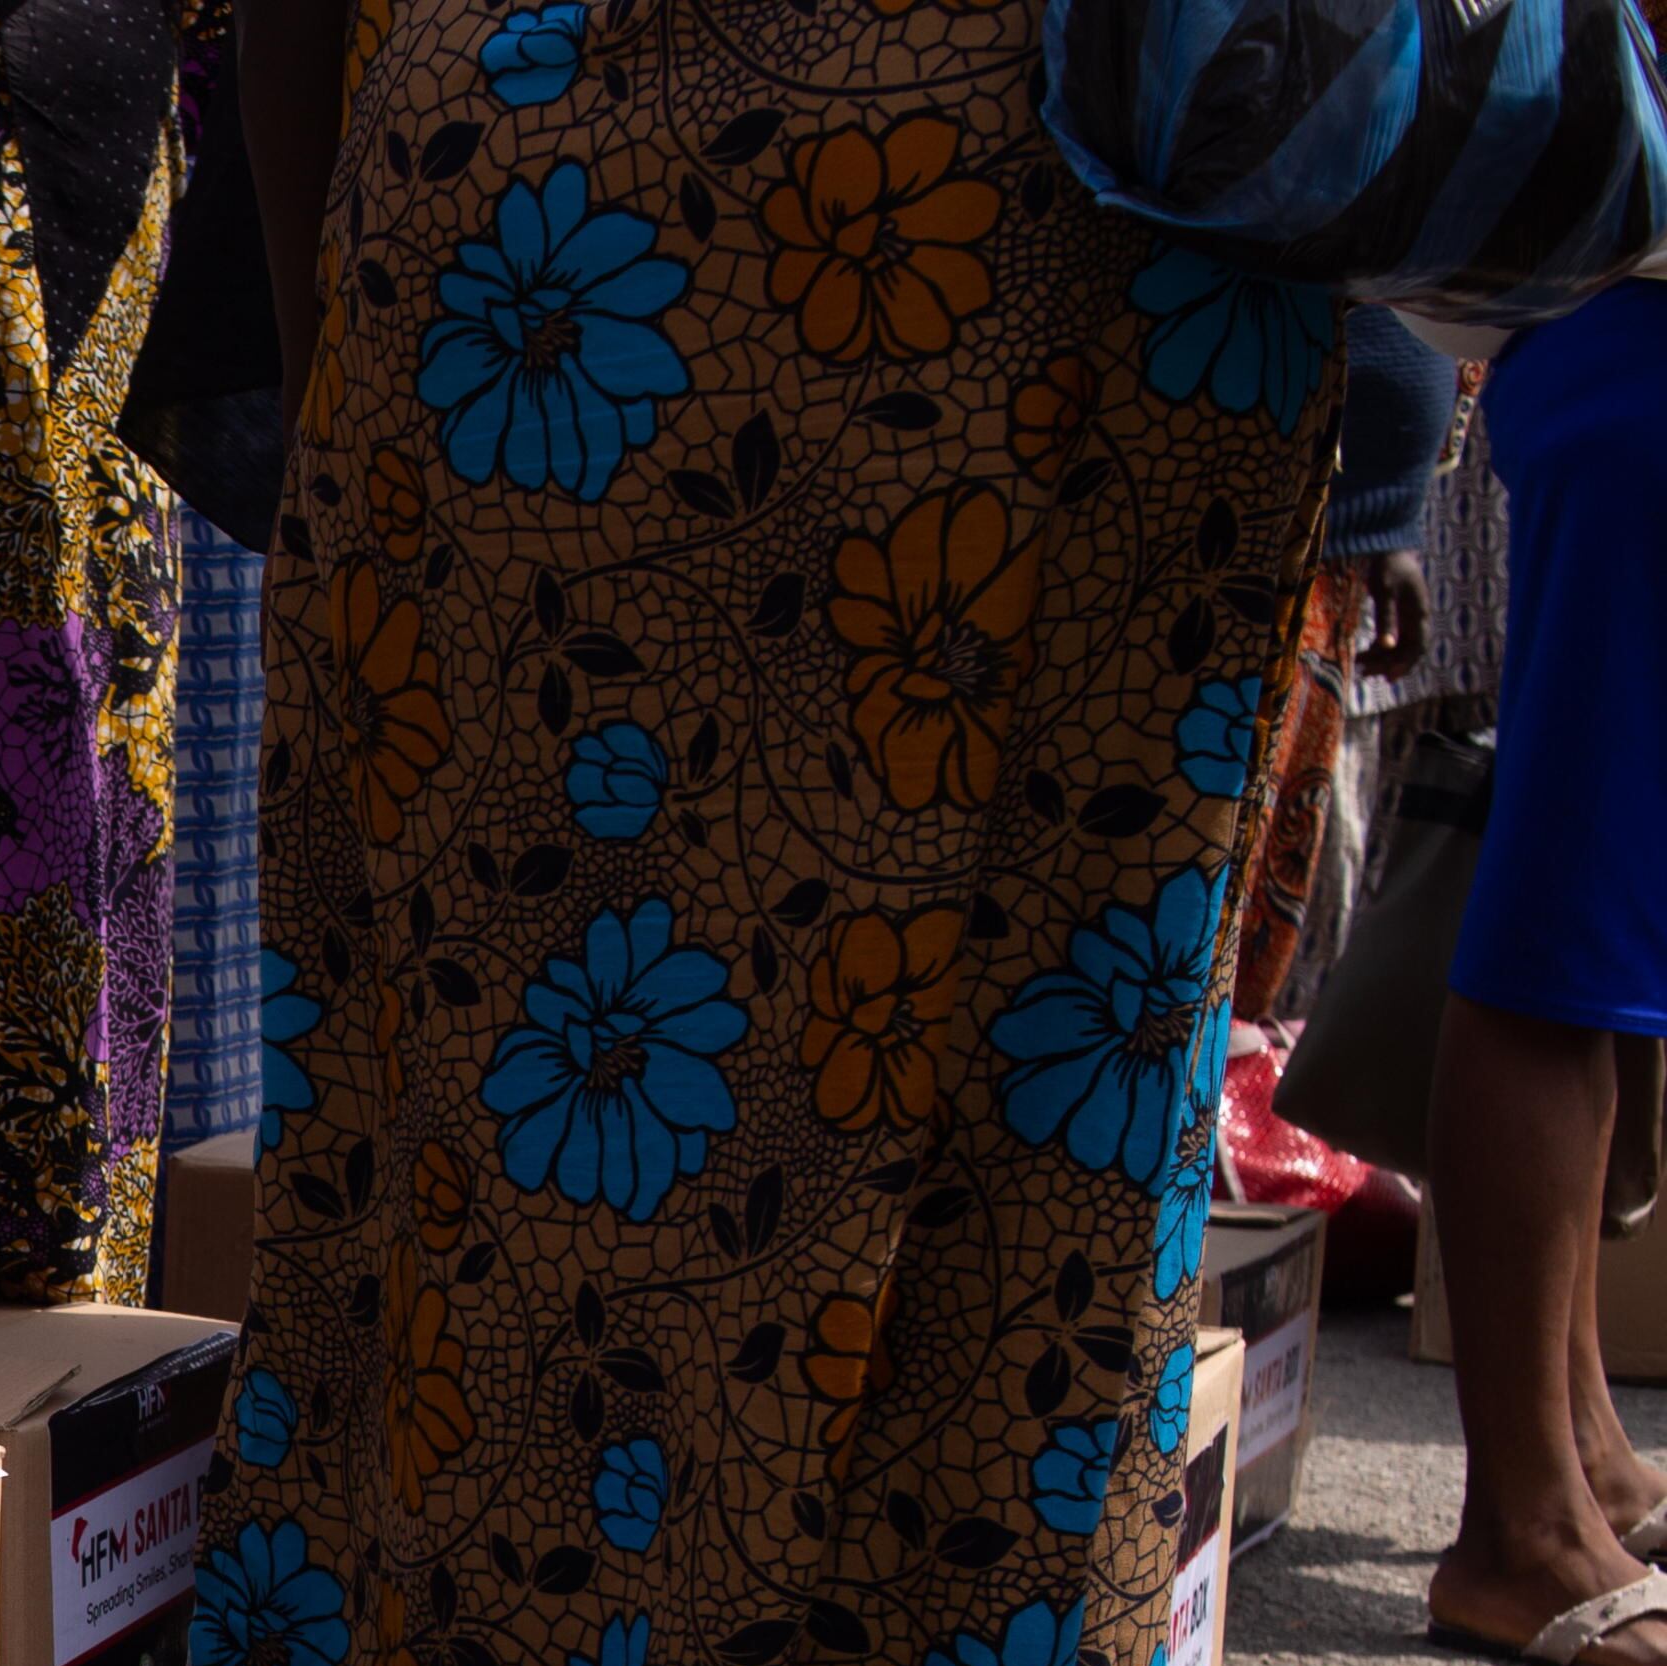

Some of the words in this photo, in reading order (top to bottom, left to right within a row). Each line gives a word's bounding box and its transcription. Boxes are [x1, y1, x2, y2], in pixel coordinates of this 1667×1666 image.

[81, 1519, 128, 1588] HFM
[134, 1482, 192, 1558] SANTA
[86, 1583, 135, 1628] Spreading
